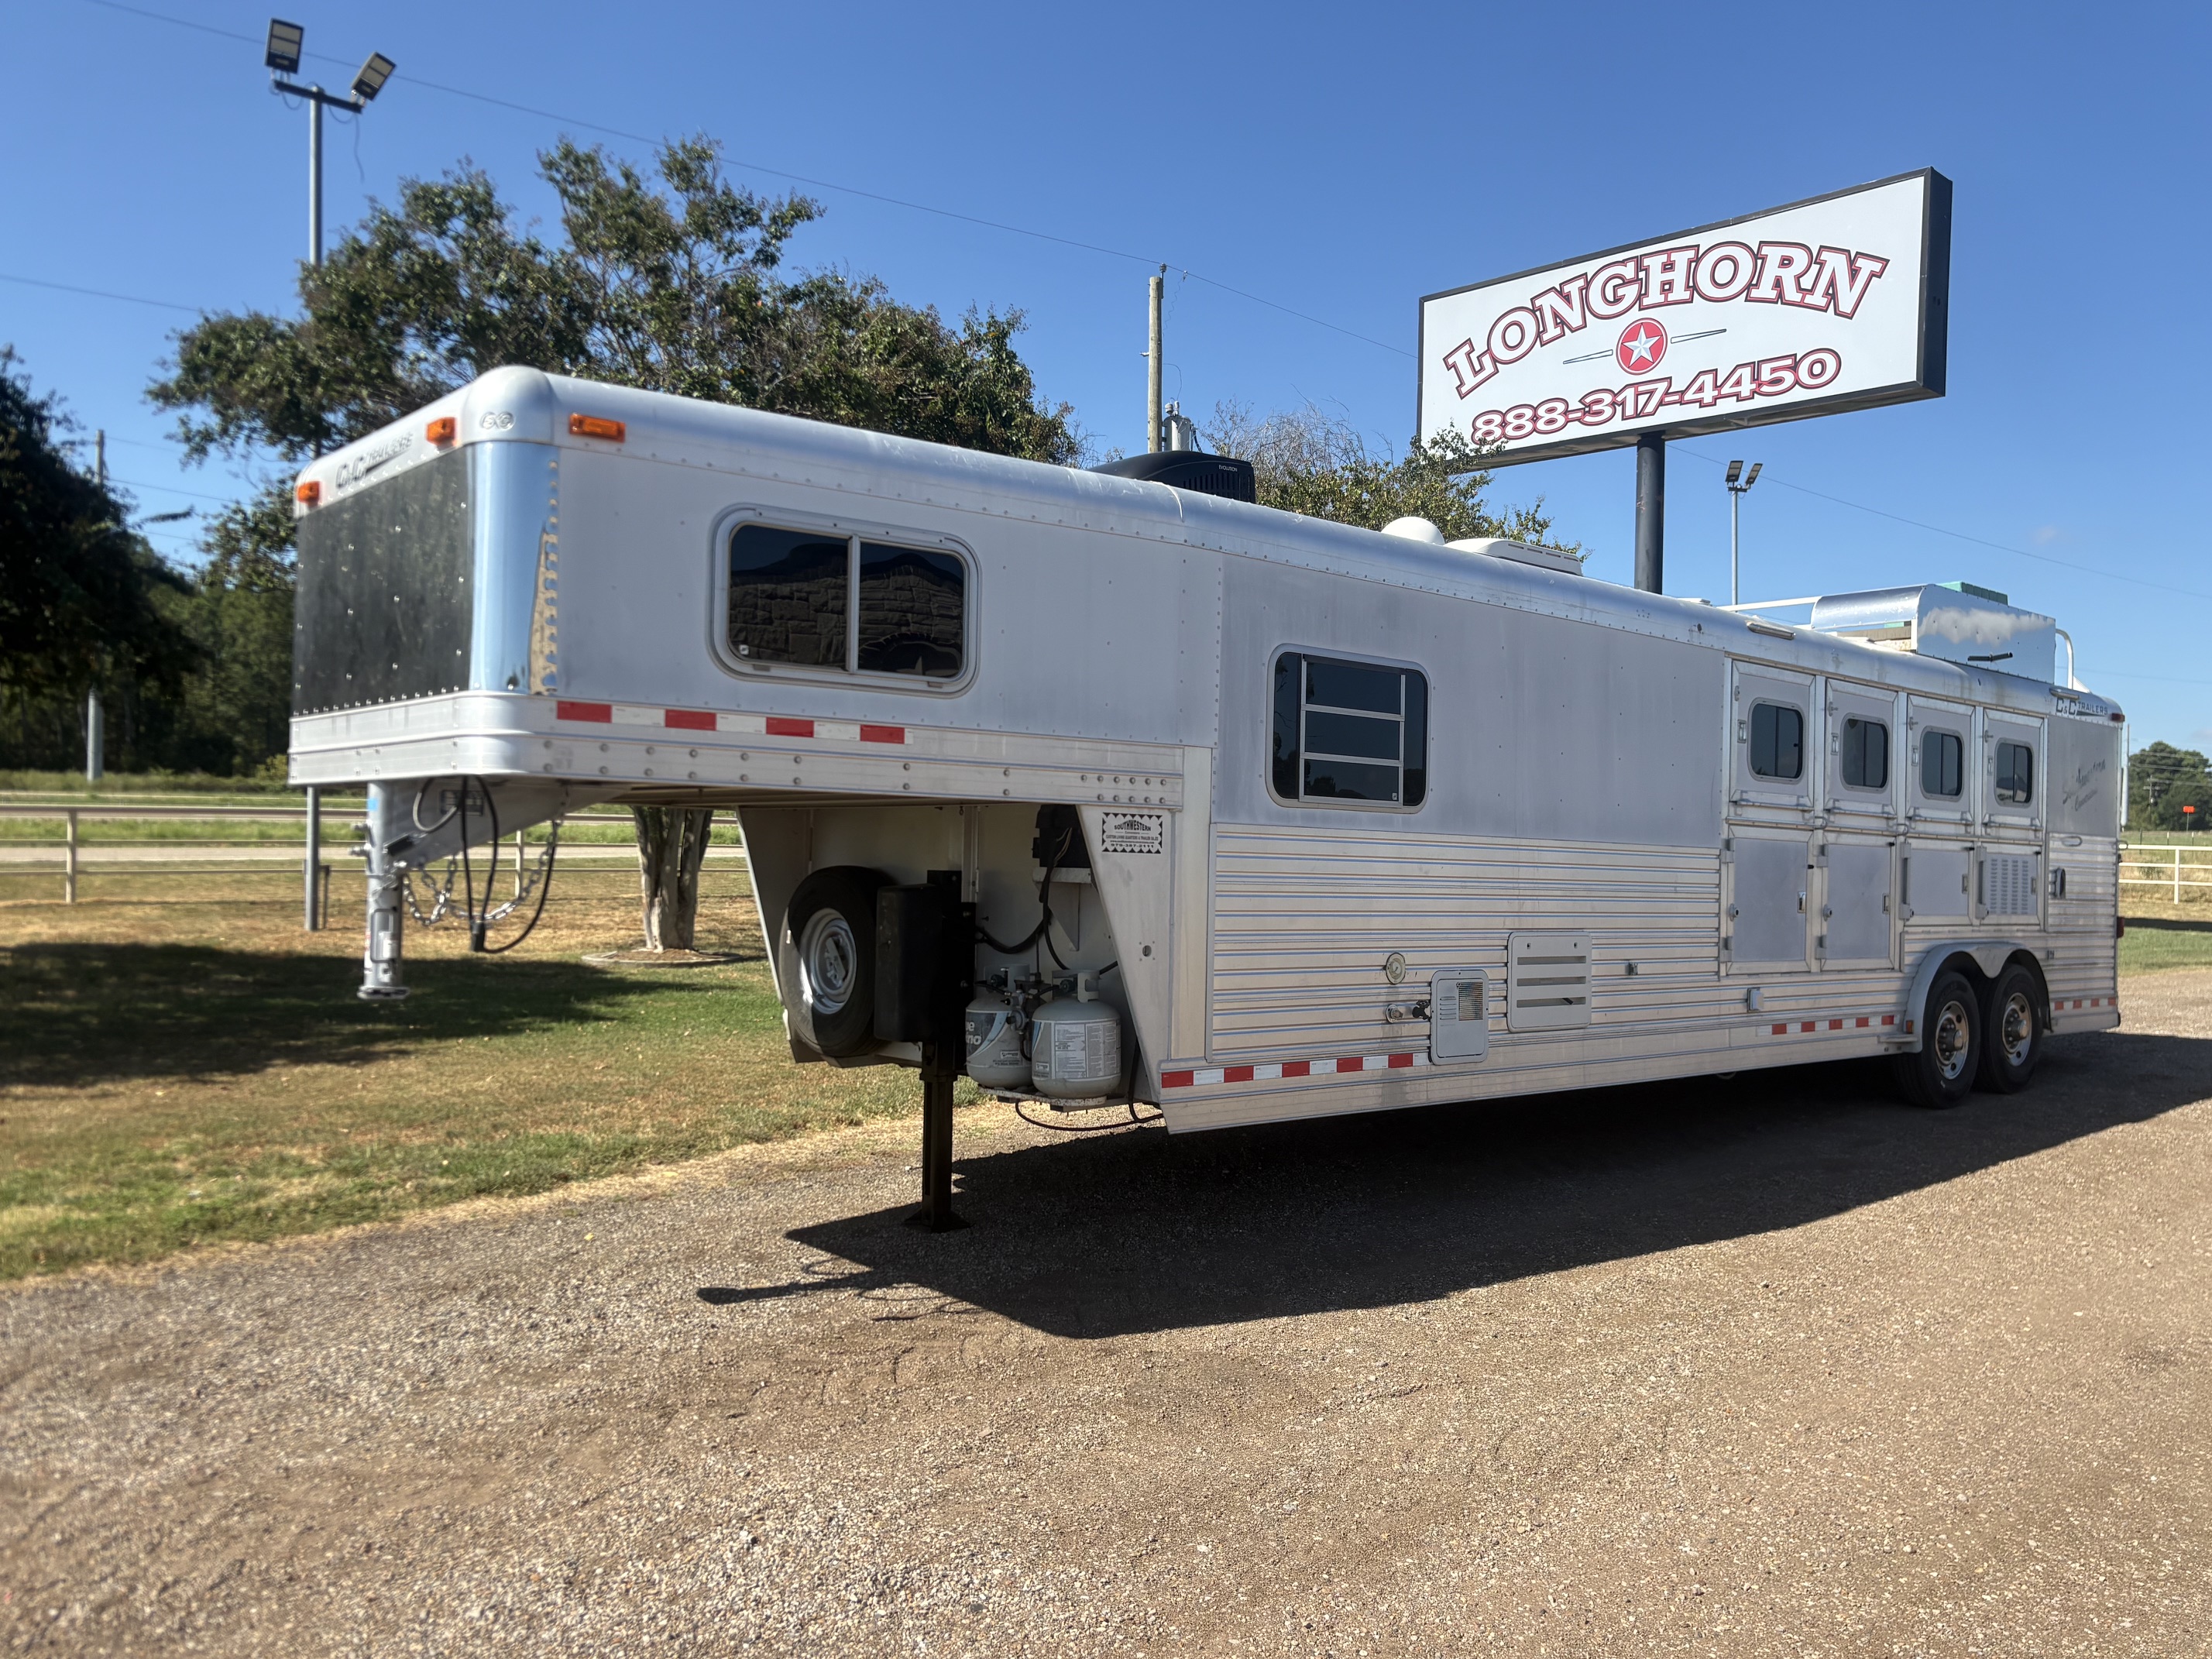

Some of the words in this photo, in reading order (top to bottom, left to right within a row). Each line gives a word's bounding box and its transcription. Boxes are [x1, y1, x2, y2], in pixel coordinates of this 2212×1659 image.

[1442, 241, 1891, 400] LONGHORN
[1472, 348, 1842, 445] 888-317-4450
[2056, 697, 2076, 716] C&C
[2077, 701, 2108, 716] TRAILERS
[1115, 820, 1151, 831] SOUTHWESTERN
[966, 1021, 975, 1031] ue
[966, 1032, 982, 1045] ino
